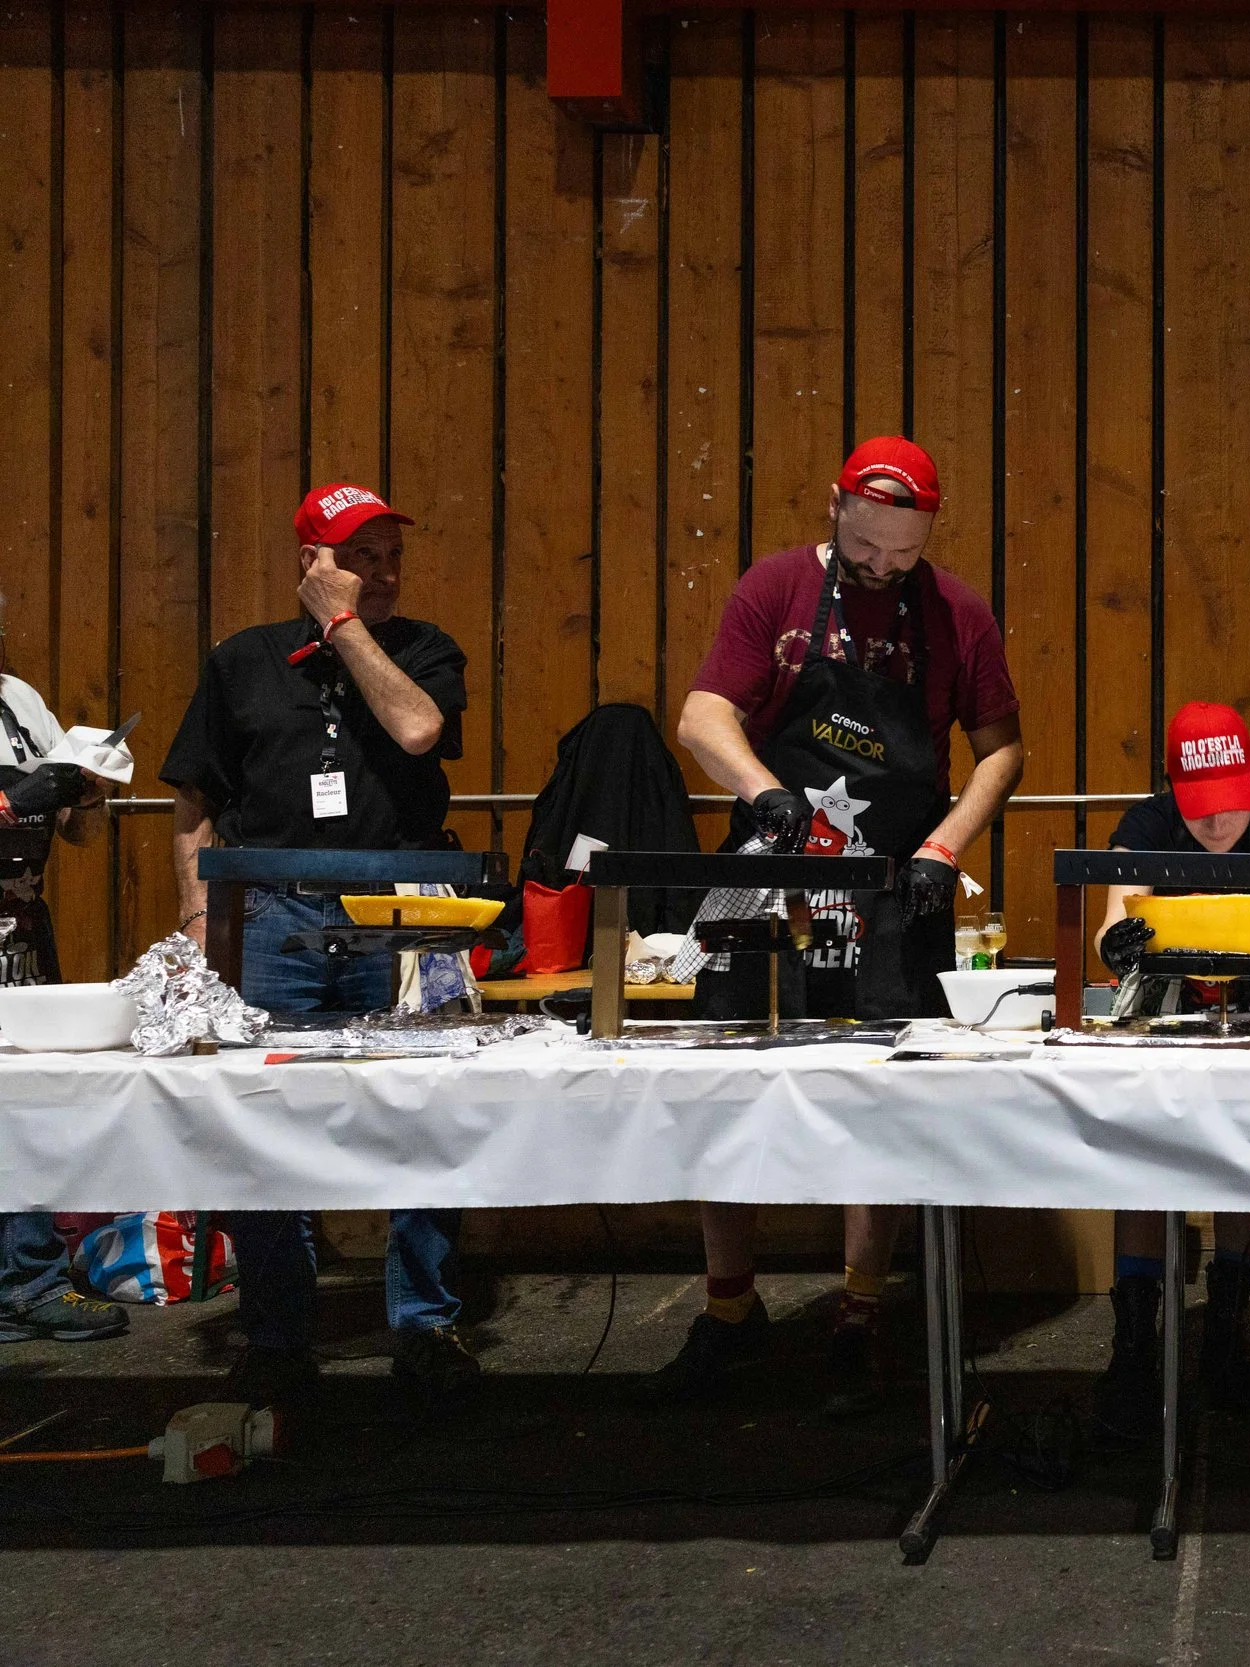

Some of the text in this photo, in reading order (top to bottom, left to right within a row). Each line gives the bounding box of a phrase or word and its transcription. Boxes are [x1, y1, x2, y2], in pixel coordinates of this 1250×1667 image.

[619, 199, 649, 234] 7
[812, 718, 885, 762] VALDOR
[831, 713, 870, 735] cremo
